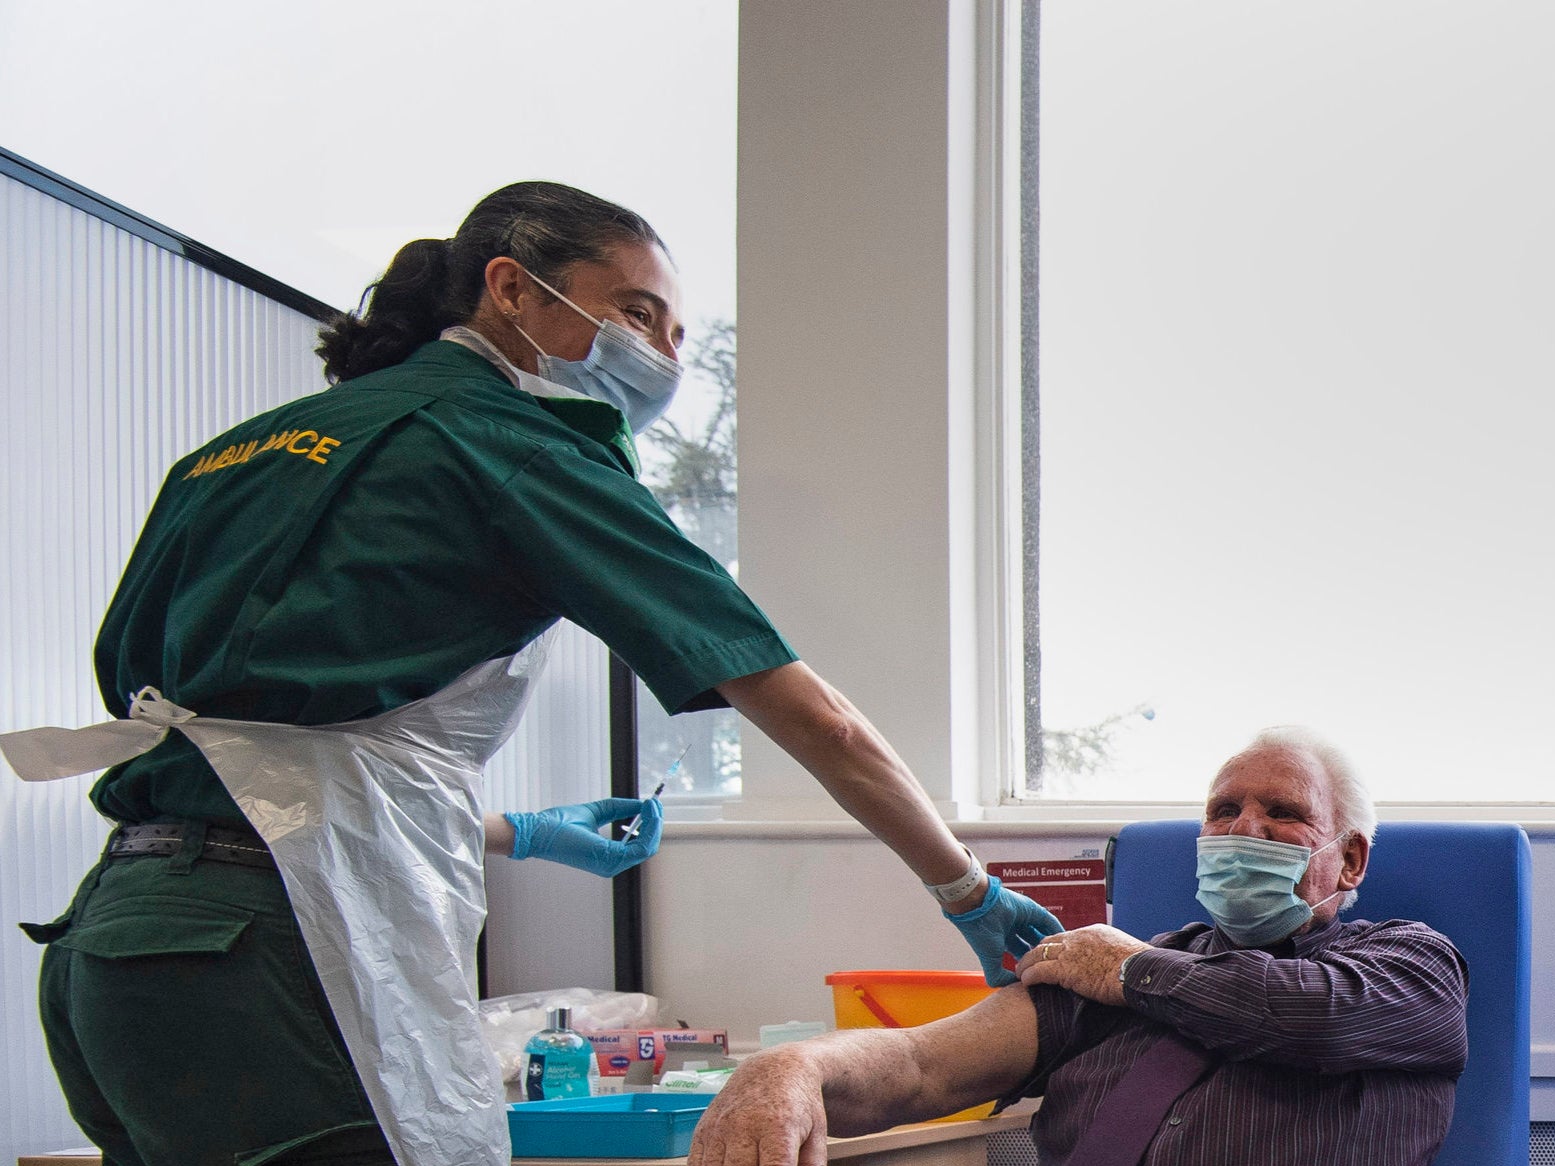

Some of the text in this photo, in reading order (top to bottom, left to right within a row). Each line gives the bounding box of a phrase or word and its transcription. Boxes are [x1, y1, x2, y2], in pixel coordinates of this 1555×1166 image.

[1002, 867, 1091, 877] Medical Emergency
[587, 1035, 620, 1043] Medical
